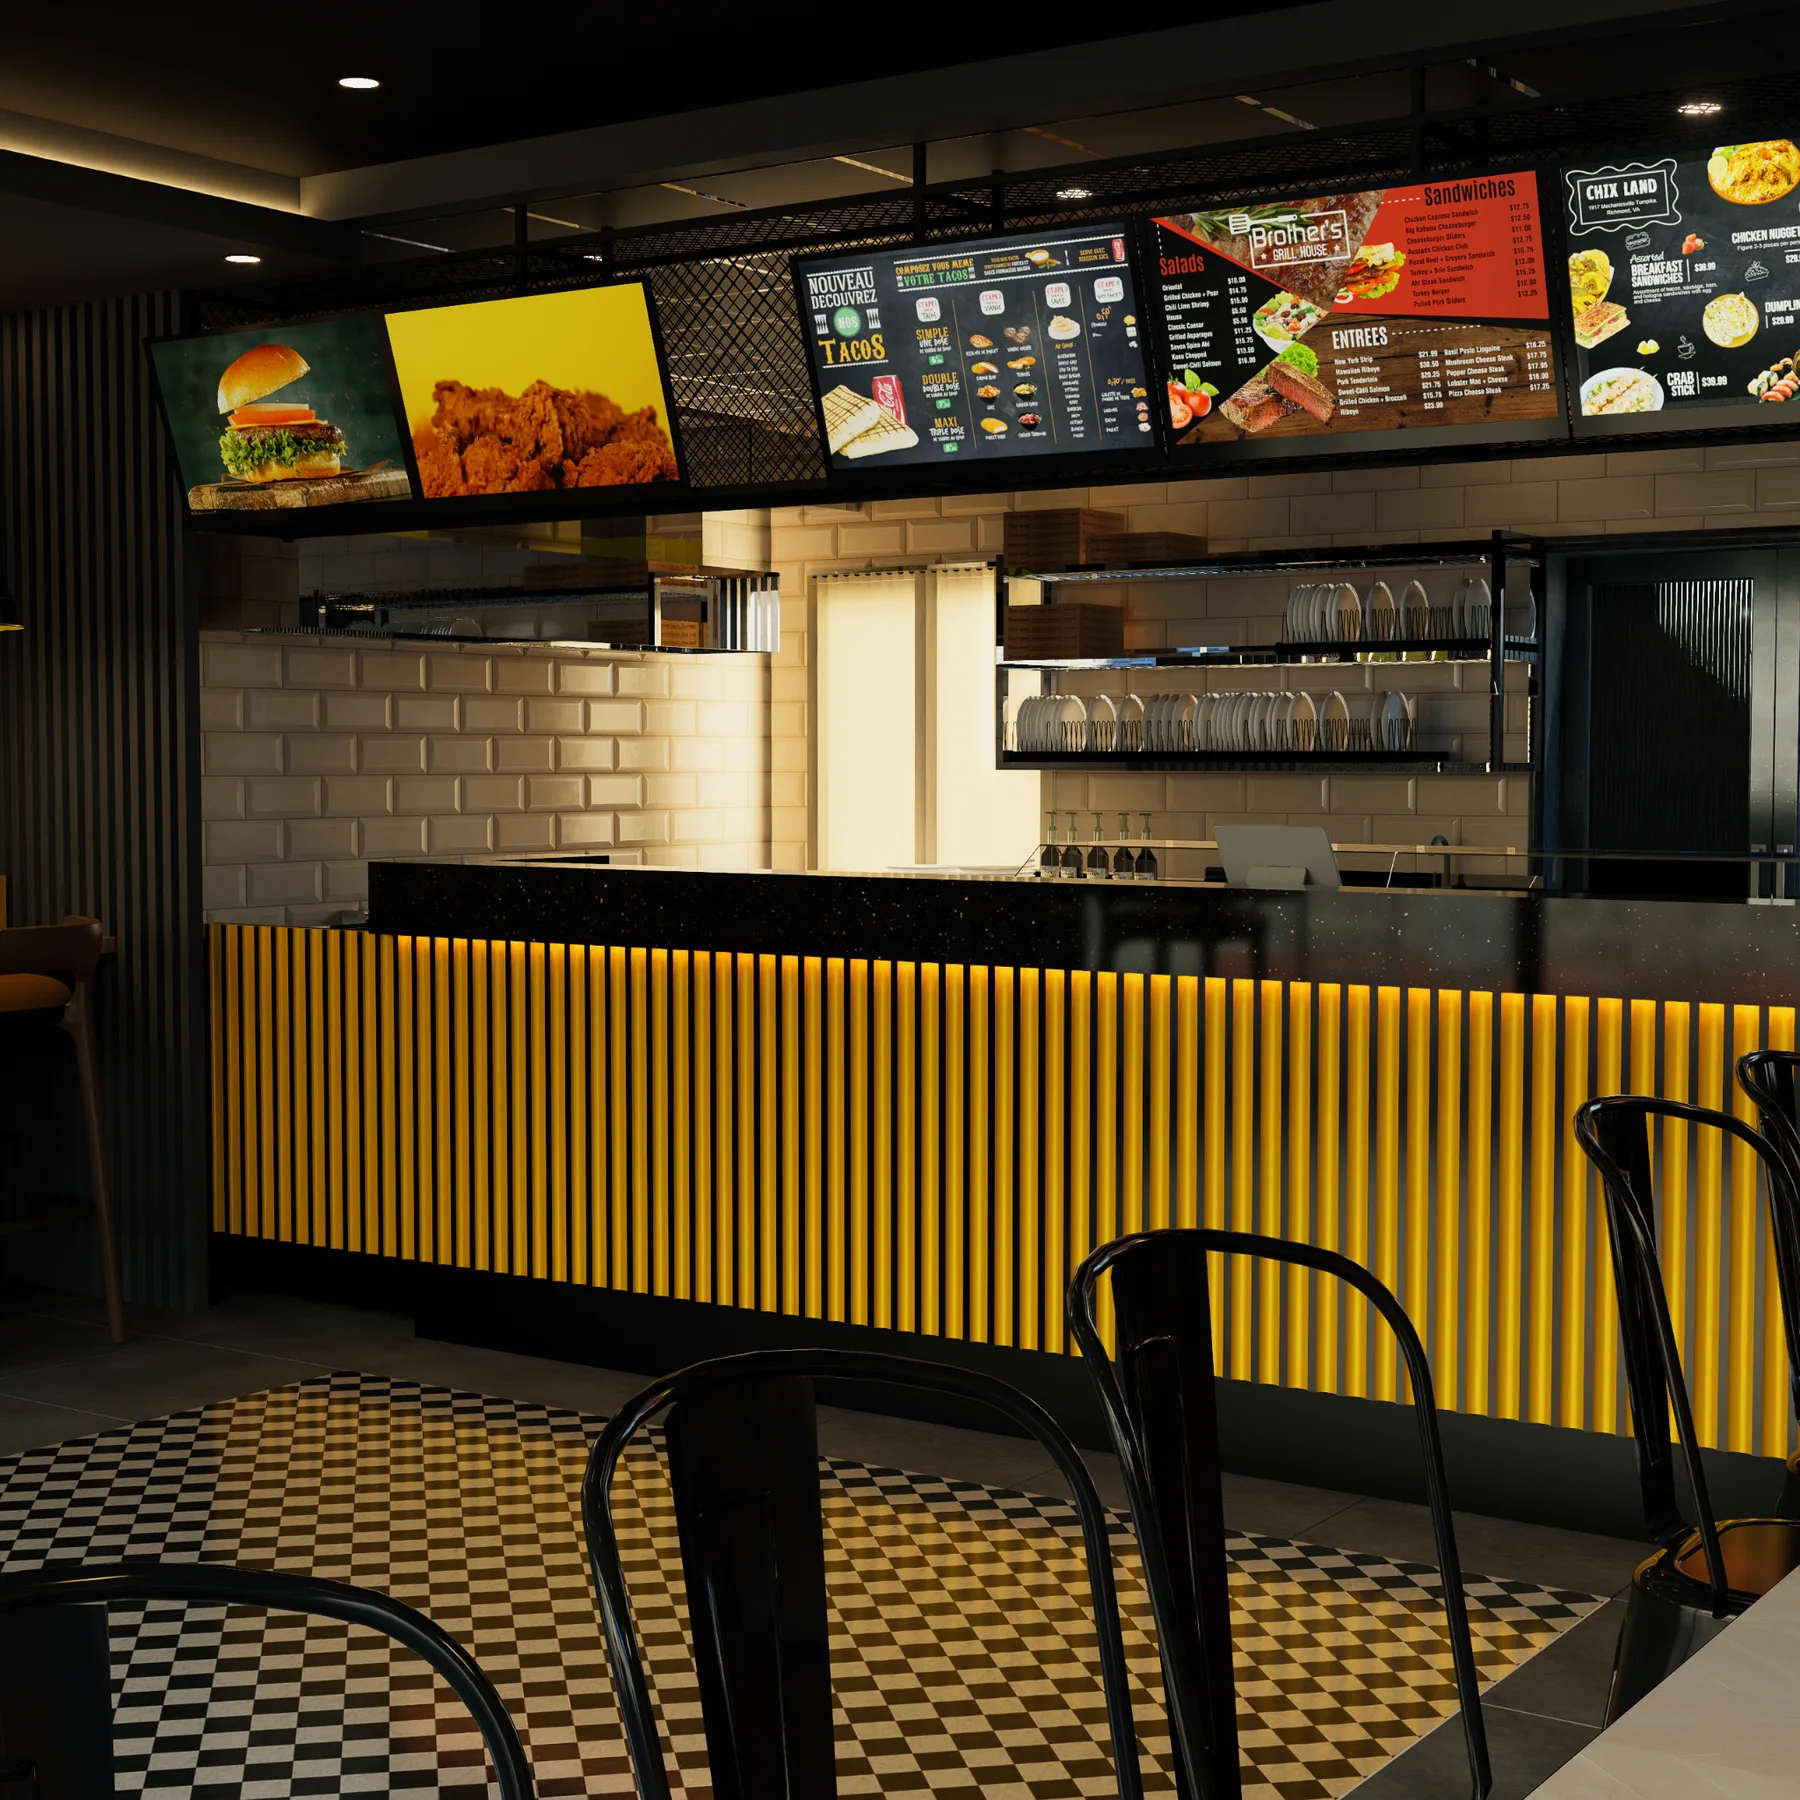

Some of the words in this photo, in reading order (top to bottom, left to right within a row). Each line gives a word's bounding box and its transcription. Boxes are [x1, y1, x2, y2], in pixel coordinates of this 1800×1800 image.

[1424, 180, 1515, 206] Sandwiches
[1586, 183, 1618, 200] CHIX
[1623, 178, 1657, 196] LAND
[1509, 203, 1529, 211] $12.75
[1452, 210, 1478, 218] Sandwich
[1511, 214, 1530, 222] $12.50
[1438, 221, 1476, 230] Cheeseburger
[1252, 220, 1342, 248] Brother's
[1407, 235, 1444, 244] Cheeseburger
[1732, 229, 1767, 244] CHICKEN
[1273, 248, 1297, 261] GRILL
[1300, 243, 1327, 258] HOUSE
[1630, 251, 1664, 264] Assorted
[896, 264, 930, 275] COMPOSEZ
[932, 261, 950, 270] VOUS
[952, 258, 974, 268] MEME
[1160, 254, 1204, 276] Salads
[1631, 260, 1683, 276] BREAKFAST
[808, 271, 874, 294] NOUVEAU
[904, 274, 935, 287] VOTRE
[937, 269, 968, 283] TACOS
[1632, 272, 1683, 288] SANDWICHES
[1162, 283, 1182, 291] Oriental
[1229, 286, 1247, 295] $14.75
[810, 289, 877, 309] DECOUVREZ
[1164, 292, 1180, 301] Grilled
[1182, 292, 1201, 300] Chicken
[1230, 297, 1248, 305] $15.00
[1165, 303, 1177, 311] Chili
[1191, 301, 1209, 310] Shrimp
[838, 316, 858, 329] NOS
[916, 327, 949, 340] SIMPLE
[1169, 332, 1186, 340] Grilled
[1332, 326, 1388, 350] ENTREES
[934, 338, 948, 346] DOSE
[818, 333, 886, 364] TACOS
[1527, 351, 1547, 359] $17.75
[1528, 362, 1548, 370] $17.95
[922, 372, 958, 385] DOUBLE
[1667, 371, 1694, 386] CRAB
[1702, 376, 1727, 387] $39.99
[923, 383, 944, 393] DOUBLE
[946, 382, 960, 391] DOSE
[1530, 383, 1550, 391] $17.25
[1671, 384, 1695, 396] STICK
[934, 417, 957, 428] MAXI
[929, 428, 949, 436] TRIPLE
[951, 426, 964, 435] DOSE
